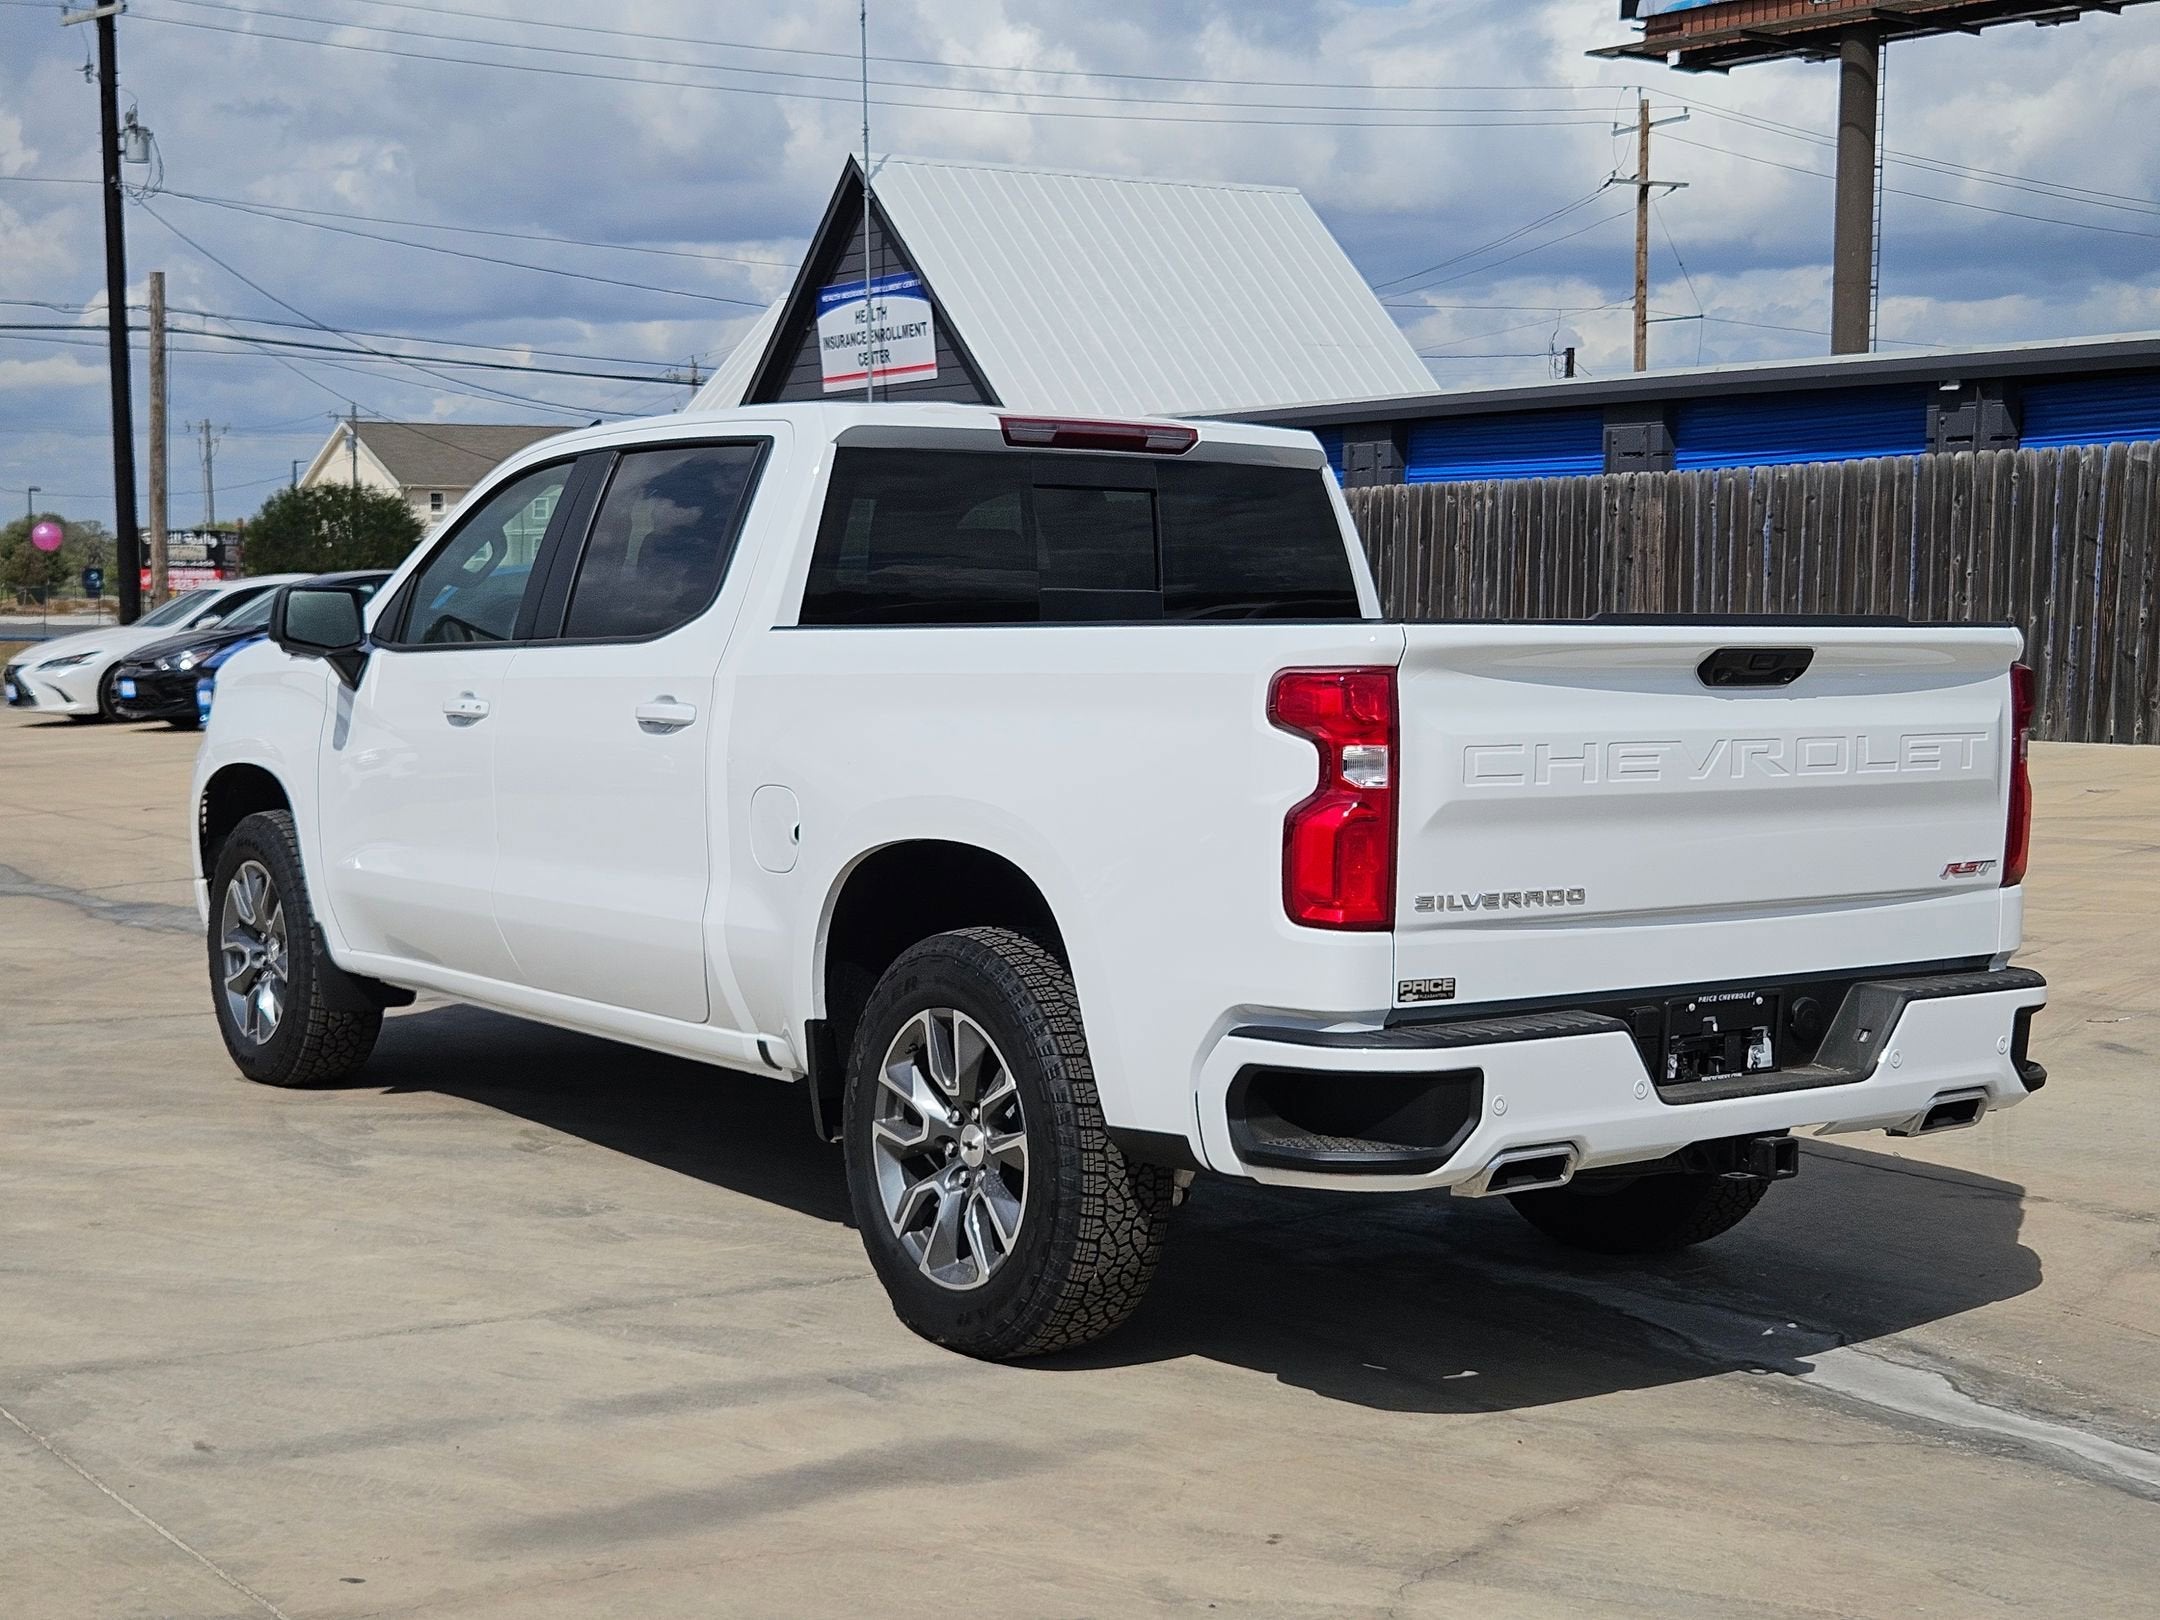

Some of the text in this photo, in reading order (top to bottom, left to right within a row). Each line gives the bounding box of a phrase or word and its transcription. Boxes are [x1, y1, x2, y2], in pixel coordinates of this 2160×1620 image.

[855, 306, 888, 324] HELTH
[823, 321, 927, 350] INSURANCE ENROLLMENT
[1462, 730, 1990, 788] CHEVROLET
[1938, 859, 1998, 881] RST
[1414, 887, 1586, 913] SILVERADO
[1400, 979, 1454, 994] PRICE
[1698, 991, 1755, 1003] PRICE CHEVROLET
